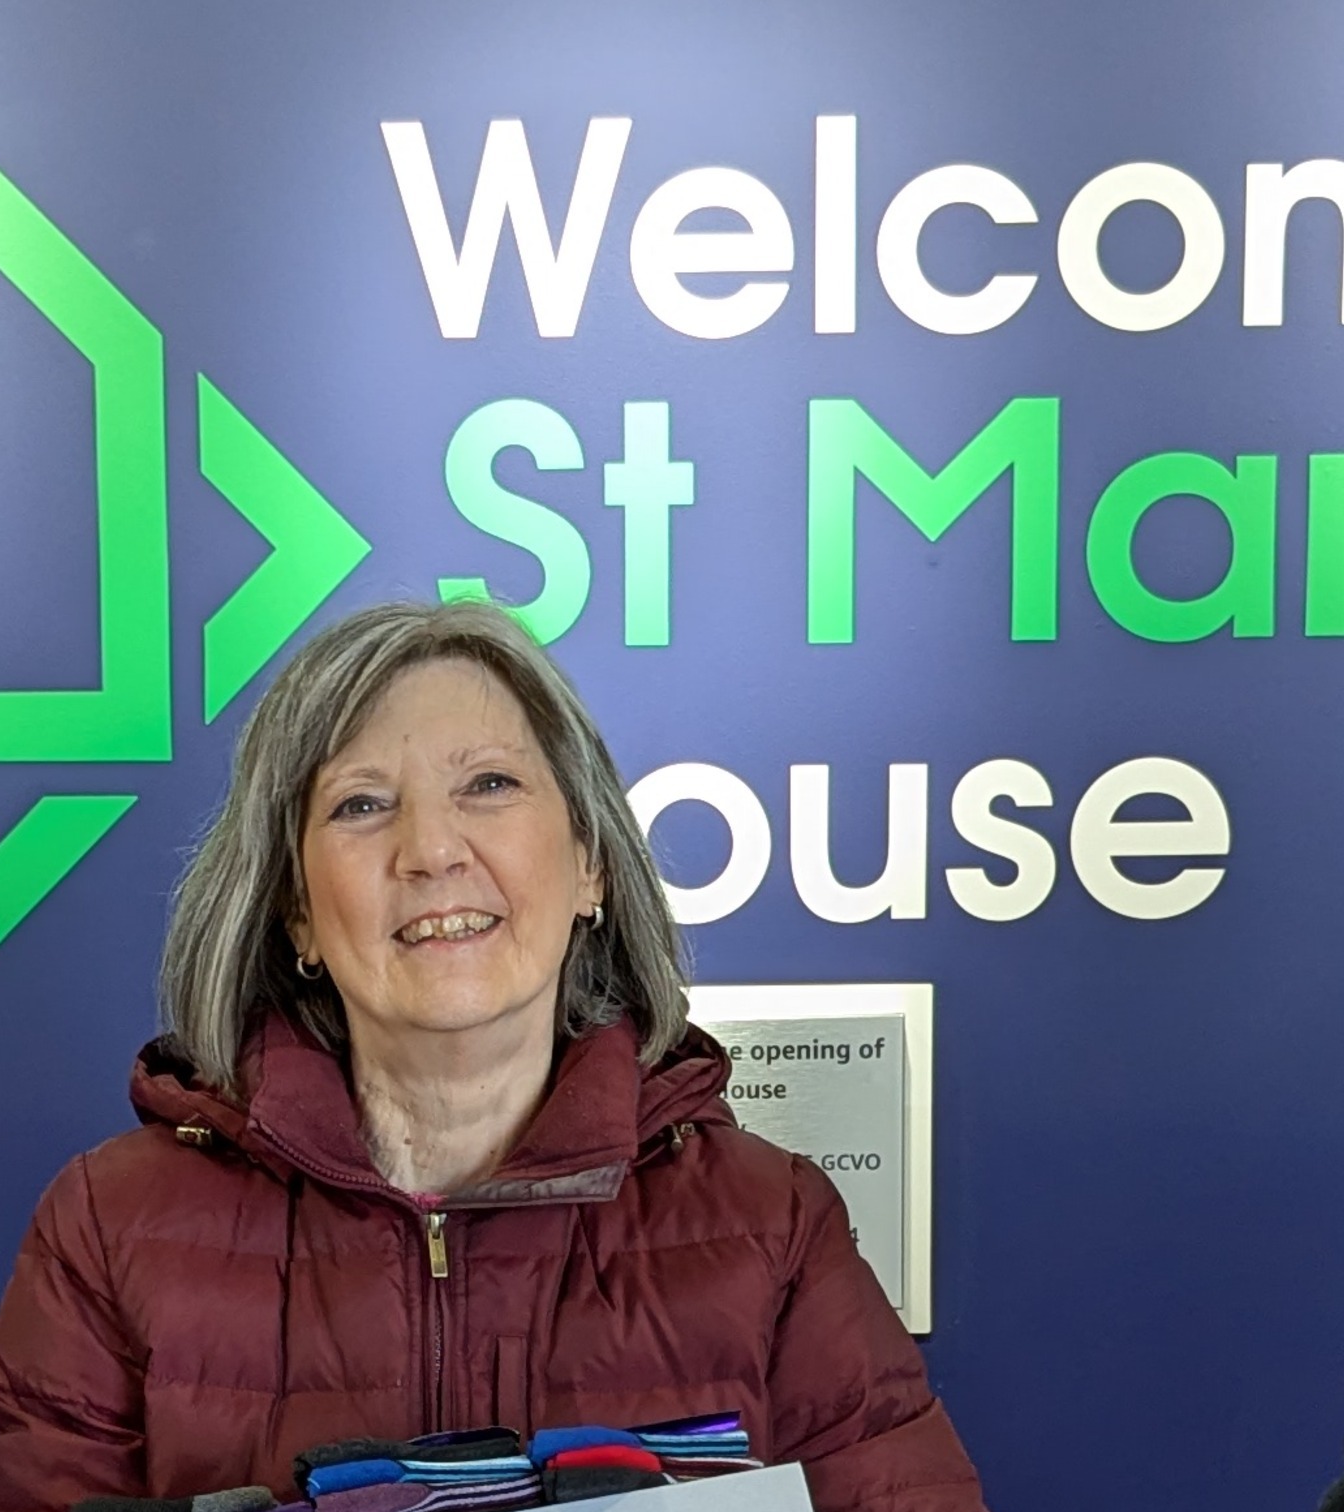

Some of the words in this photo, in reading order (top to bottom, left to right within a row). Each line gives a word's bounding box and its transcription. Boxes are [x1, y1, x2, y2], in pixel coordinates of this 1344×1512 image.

[437, 398, 694, 650] St
[626, 757, 1230, 925] ouse
[750, 1038, 850, 1065] opening
[859, 1037, 885, 1059] of
[821, 1153, 881, 1171] GCVO
